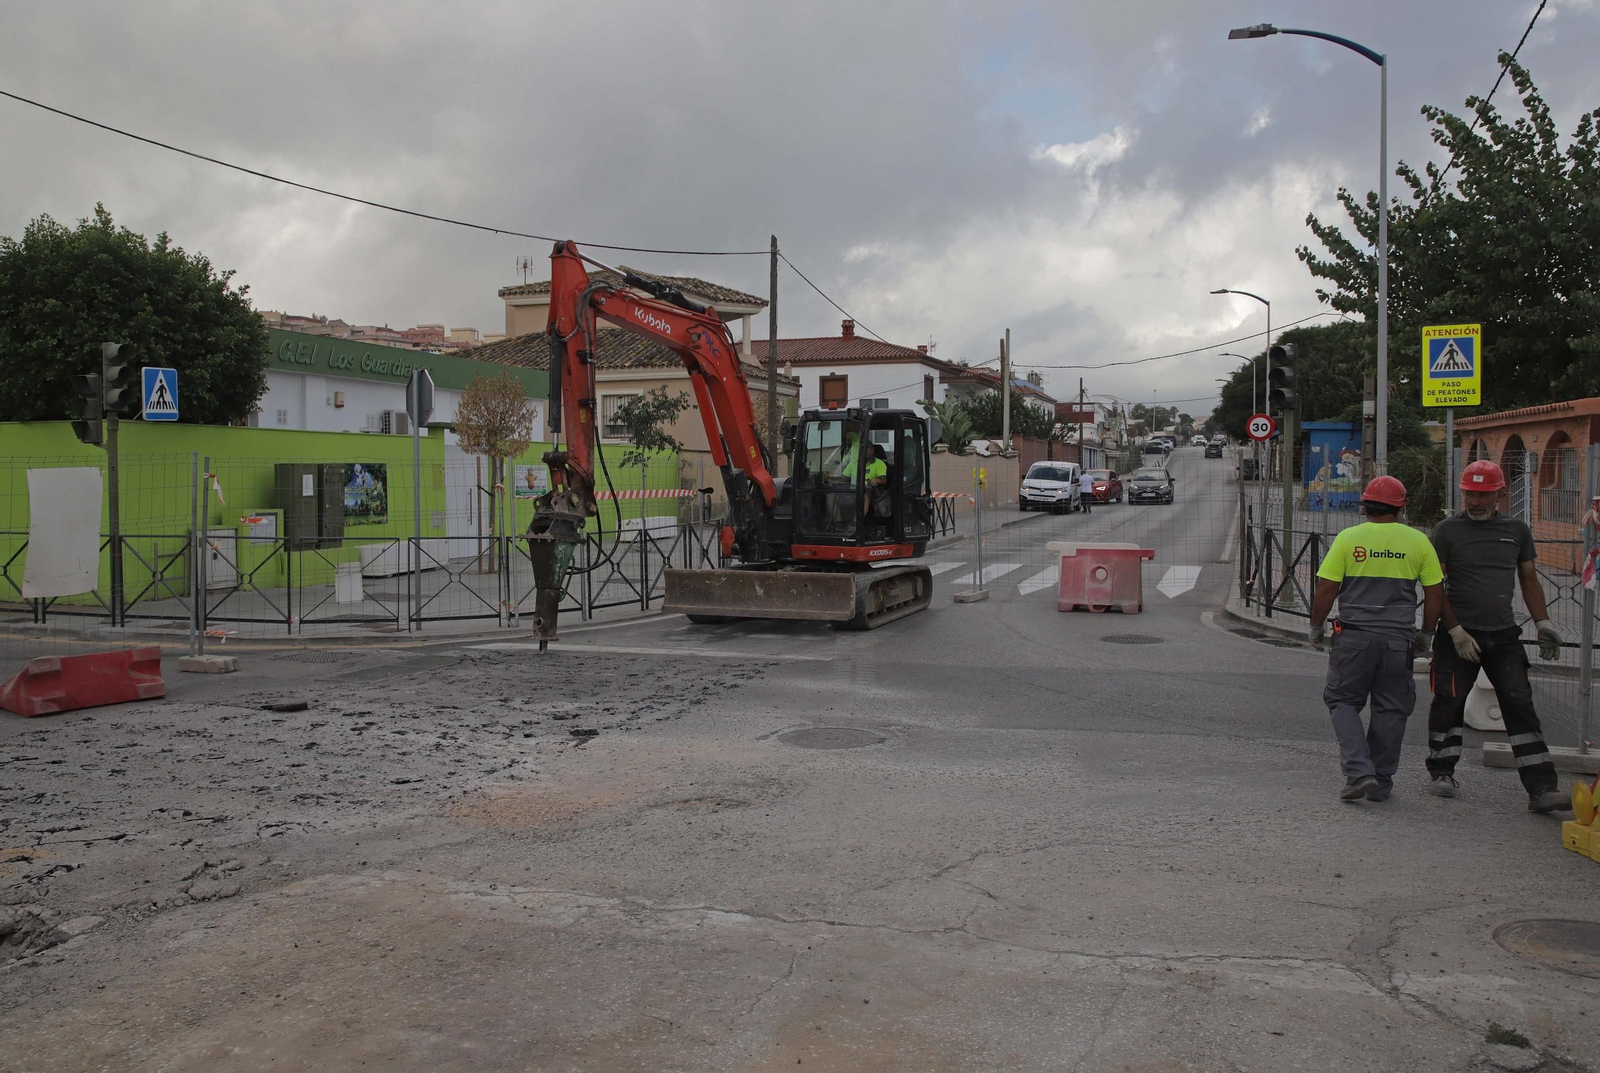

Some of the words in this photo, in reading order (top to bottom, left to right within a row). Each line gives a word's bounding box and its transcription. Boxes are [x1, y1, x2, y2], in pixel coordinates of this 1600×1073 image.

[634, 306, 671, 334] Kubota
[1424, 325, 1479, 337] ATENCIÓN
[329, 347, 356, 369] Los
[1438, 388, 1476, 396] PEATONES
[1252, 422, 1268, 432] 30
[1369, 548, 1406, 559] laribar
